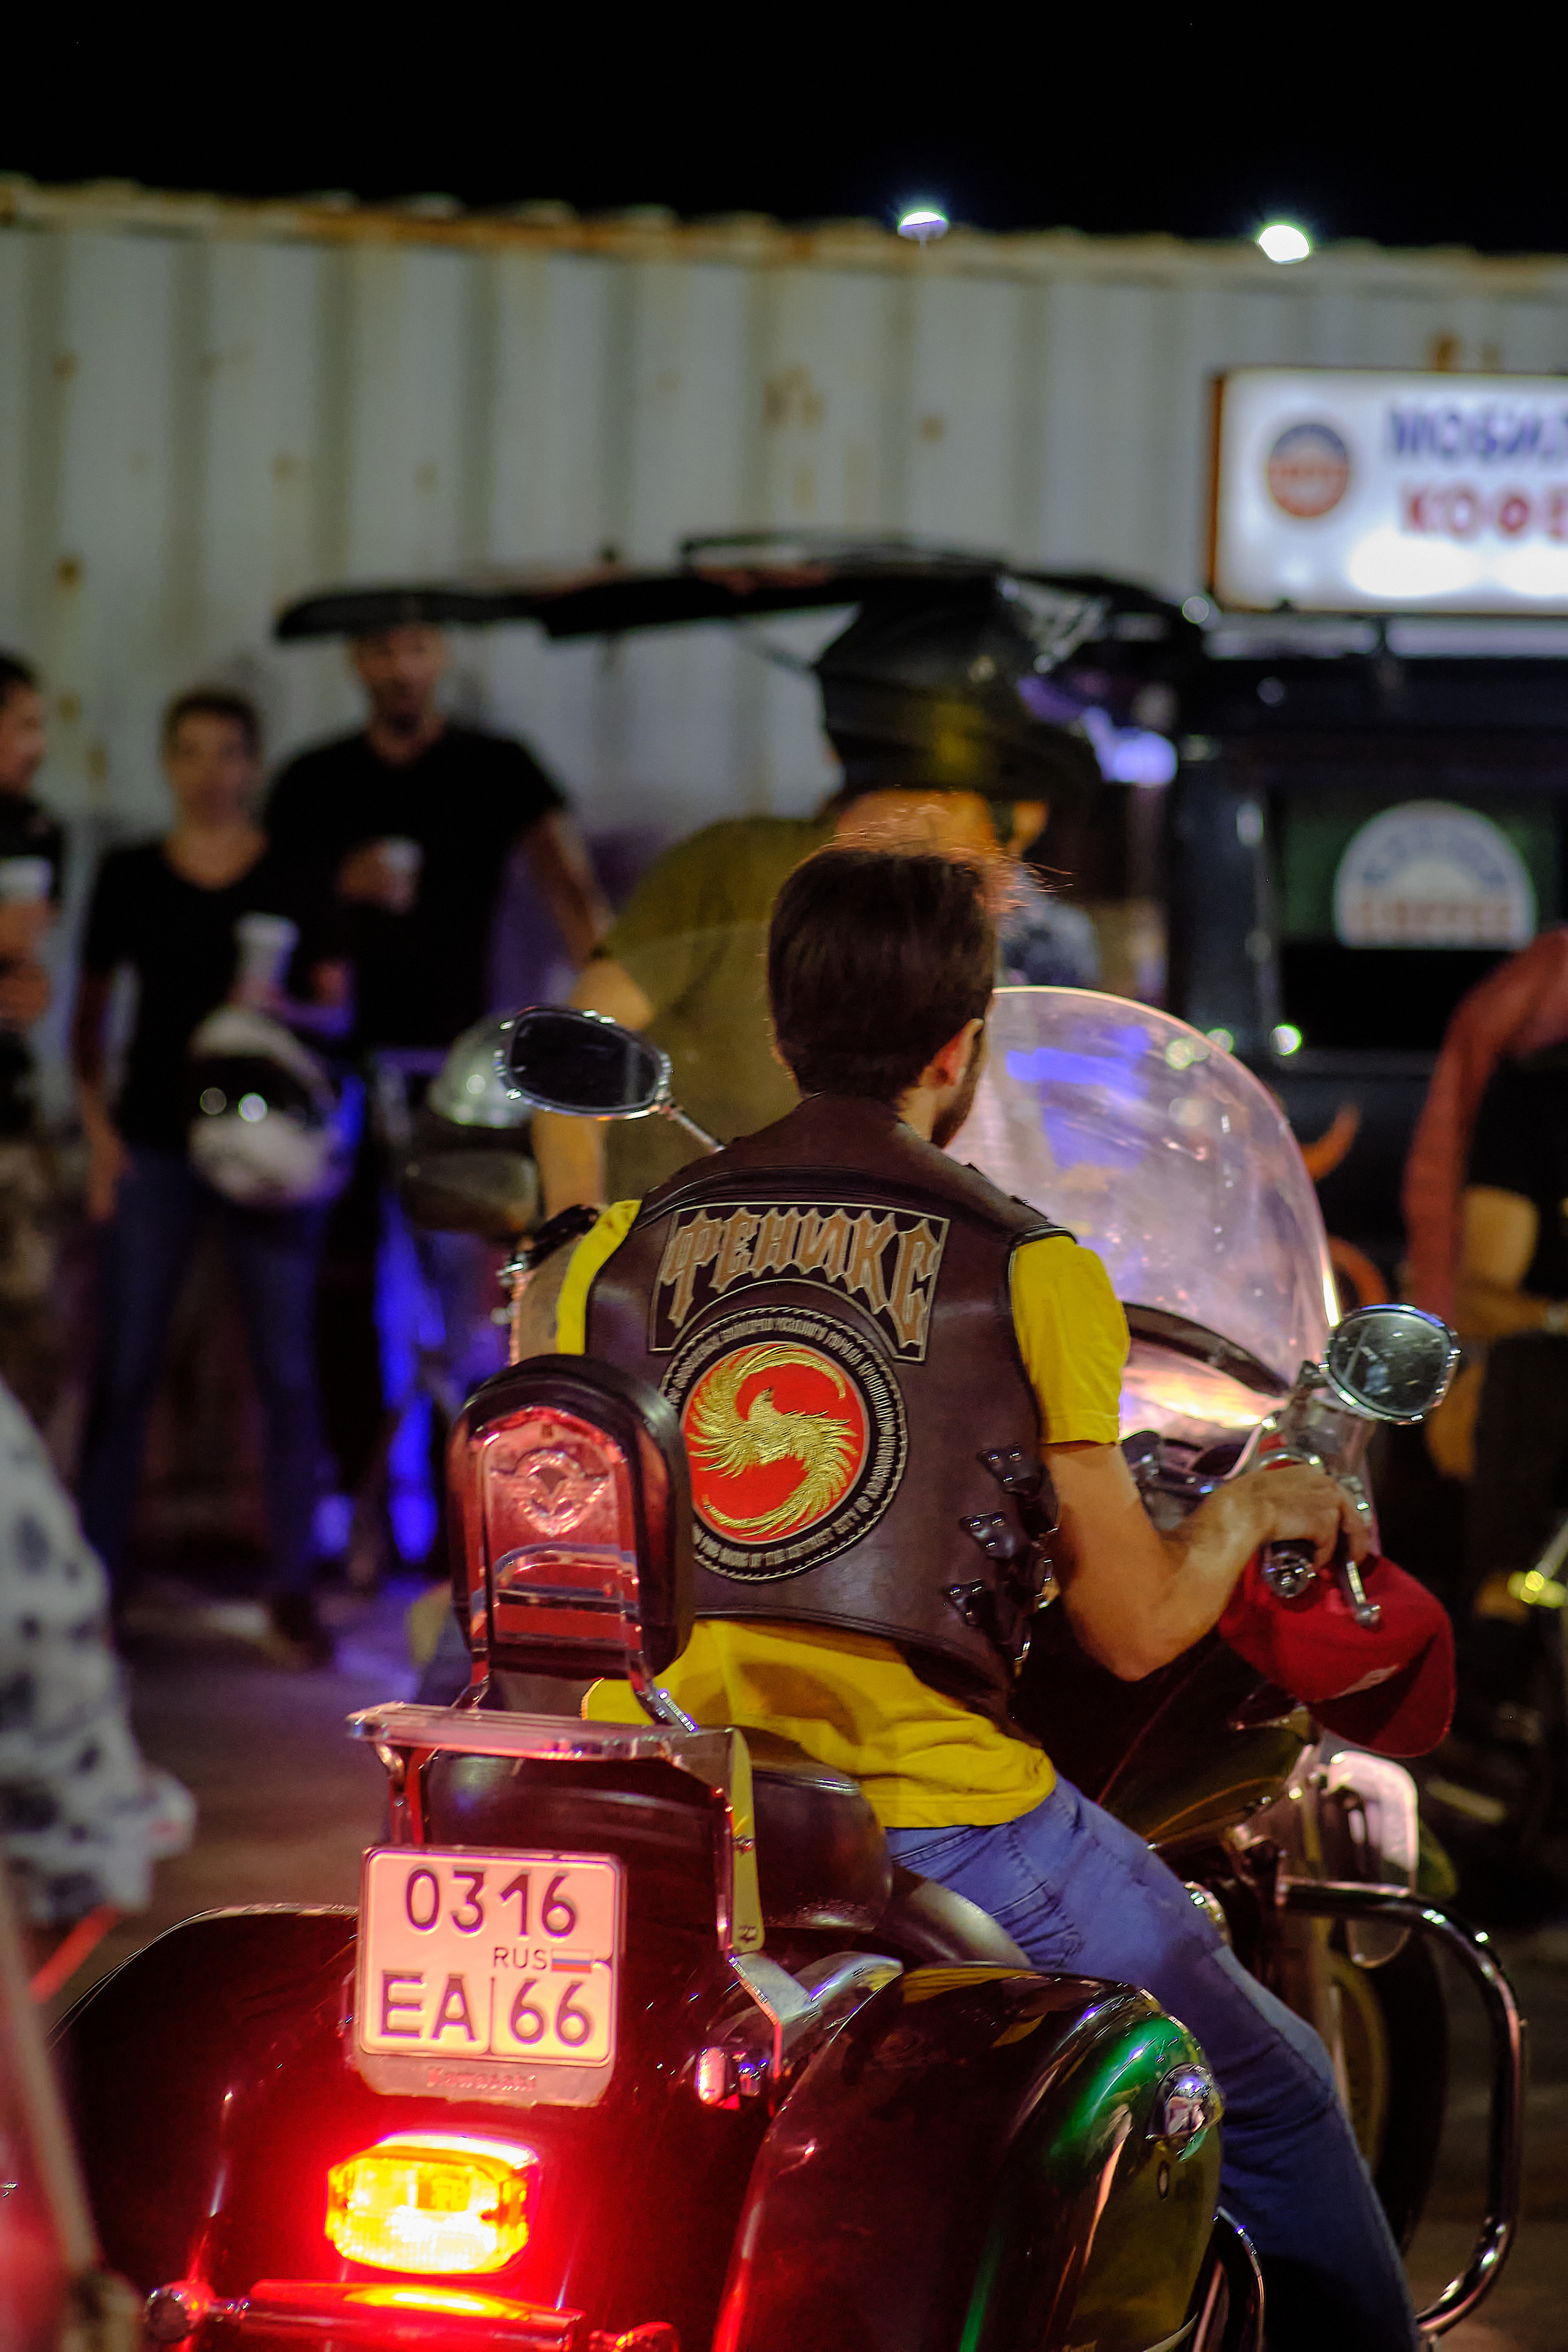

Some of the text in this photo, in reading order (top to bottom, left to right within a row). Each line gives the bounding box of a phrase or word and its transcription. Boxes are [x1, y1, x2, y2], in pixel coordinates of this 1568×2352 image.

[659, 1207, 940, 1349] ФЕНИКС
[405, 1864, 577, 1938] 0316
[492, 1947, 549, 1971] RUS
[508, 1977, 592, 2048] 66
